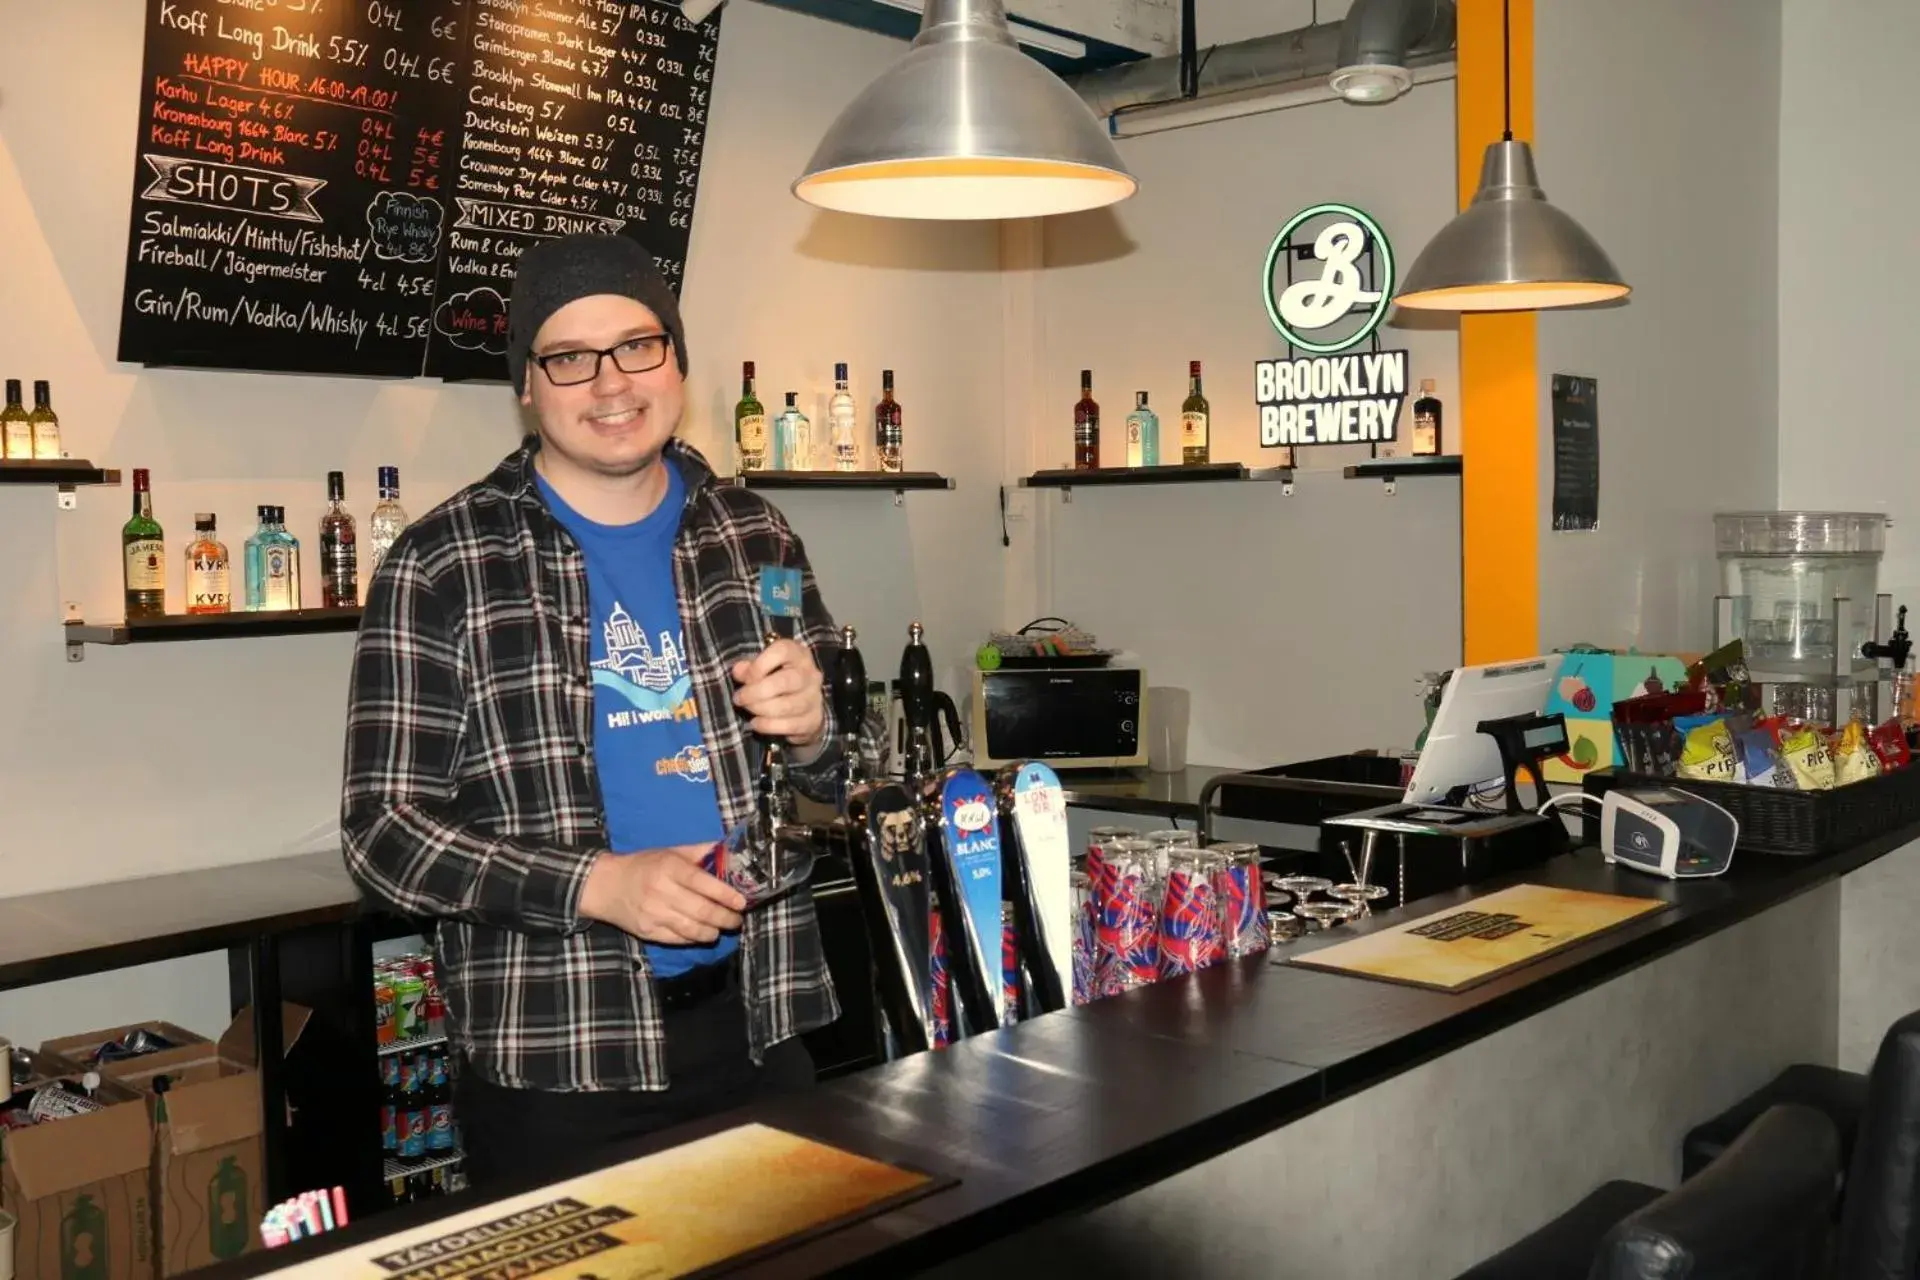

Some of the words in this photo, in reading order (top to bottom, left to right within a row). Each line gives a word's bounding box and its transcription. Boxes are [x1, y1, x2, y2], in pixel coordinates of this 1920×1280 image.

[160, 0, 208, 37] Koff
[217, 15, 264, 61] Long
[271, 25, 321, 60] Drink
[427, 56, 456, 84] 6€
[431, 16, 457, 40] 6€
[575, 12, 599, 31] Ale
[601, 19, 622, 36] 5%
[698, 43, 714, 63] 7€
[630, 4, 648, 24] IPA
[651, 10, 670, 26] 6%
[702, 22, 718, 41] 7€
[183, 52, 249, 82] HAPPY
[474, 33, 538, 68] Grimbergen
[689, 86, 707, 106] 7€
[556, 31, 584, 51] Dark
[587, 37, 617, 63] Lager
[693, 64, 710, 83] 6€
[155, 76, 198, 104] Karhu
[206, 84, 256, 119] Lager
[418, 126, 445, 147] 4€
[472, 60, 525, 93] Brooklyn
[607, 88, 624, 107] IPA
[687, 106, 705, 125] 8€
[153, 100, 234, 139] Kronenbourg
[240, 119, 270, 138] 1664
[274, 124, 310, 147] Blanc
[313, 130, 339, 151] 5%
[411, 146, 440, 168] 5€
[464, 110, 531, 139] Duckstein
[536, 124, 580, 146] Weizen
[469, 85, 536, 122] Carlsberg
[539, 100, 566, 121] 5%
[682, 127, 702, 146] 7€
[152, 123, 191, 150] Koff
[195, 131, 235, 164] Long
[239, 141, 285, 165] Drink
[408, 168, 441, 190] 5€
[527, 145, 555, 163] 1664
[558, 150, 586, 167] Blanc
[591, 155, 609, 171] 0%
[675, 169, 696, 188] 5€
[168, 165, 292, 211] SHOTS
[457, 175, 510, 201] Somersby
[513, 183, 536, 199] Pear
[539, 188, 568, 208] Cider
[669, 210, 689, 228] 6€
[518, 166, 538, 187] Dry
[538, 168, 568, 187] Apple
[572, 173, 600, 192] Cider
[673, 190, 692, 209] 6€
[376, 216, 399, 241] Rye
[470, 203, 537, 231] MIXED
[542, 215, 610, 236] DRINKS
[450, 230, 479, 253] Rum
[481, 237, 491, 253] &
[358, 267, 387, 291] 4cl
[448, 256, 489, 276] Vodka
[1279, 222, 1382, 330] B
[376, 312, 399, 337] 4cl
[403, 316, 430, 339] 5€
[451, 308, 488, 330] Wine
[1256, 351, 1405, 402] BROOKLYN
[1261, 397, 1399, 446] BREWERY
[1706, 758, 1738, 775] PIP
[956, 838, 999, 857] BLANC
